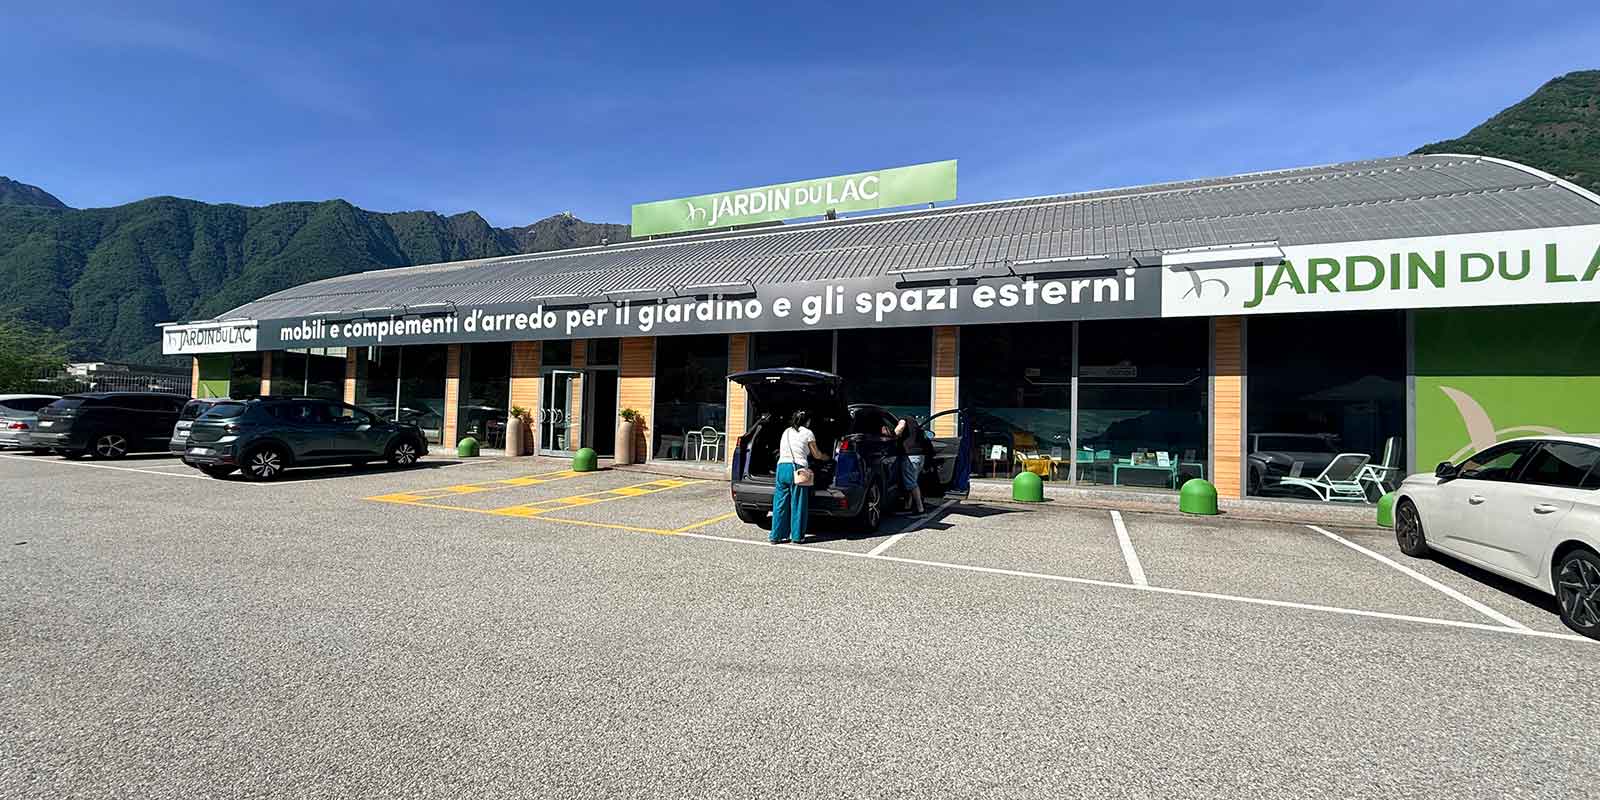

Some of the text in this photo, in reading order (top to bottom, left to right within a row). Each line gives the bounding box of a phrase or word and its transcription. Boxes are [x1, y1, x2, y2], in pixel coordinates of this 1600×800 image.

[709, 175, 880, 225] JARDIN DU LAC
[280, 320, 325, 341] mobili
[329, 325, 340, 338] e
[343, 312, 459, 342] complementi
[566, 307, 608, 334] per
[615, 300, 630, 325] il
[638, 295, 762, 331] giardino
[772, 297, 792, 317] e
[801, 285, 844, 325] gli
[855, 279, 958, 322] spazi
[972, 267, 1136, 308] esterni
[1243, 250, 1446, 308] JARDIN
[1460, 249, 1530, 283] DU
[178, 326, 252, 351] JARDIN DU LAC
